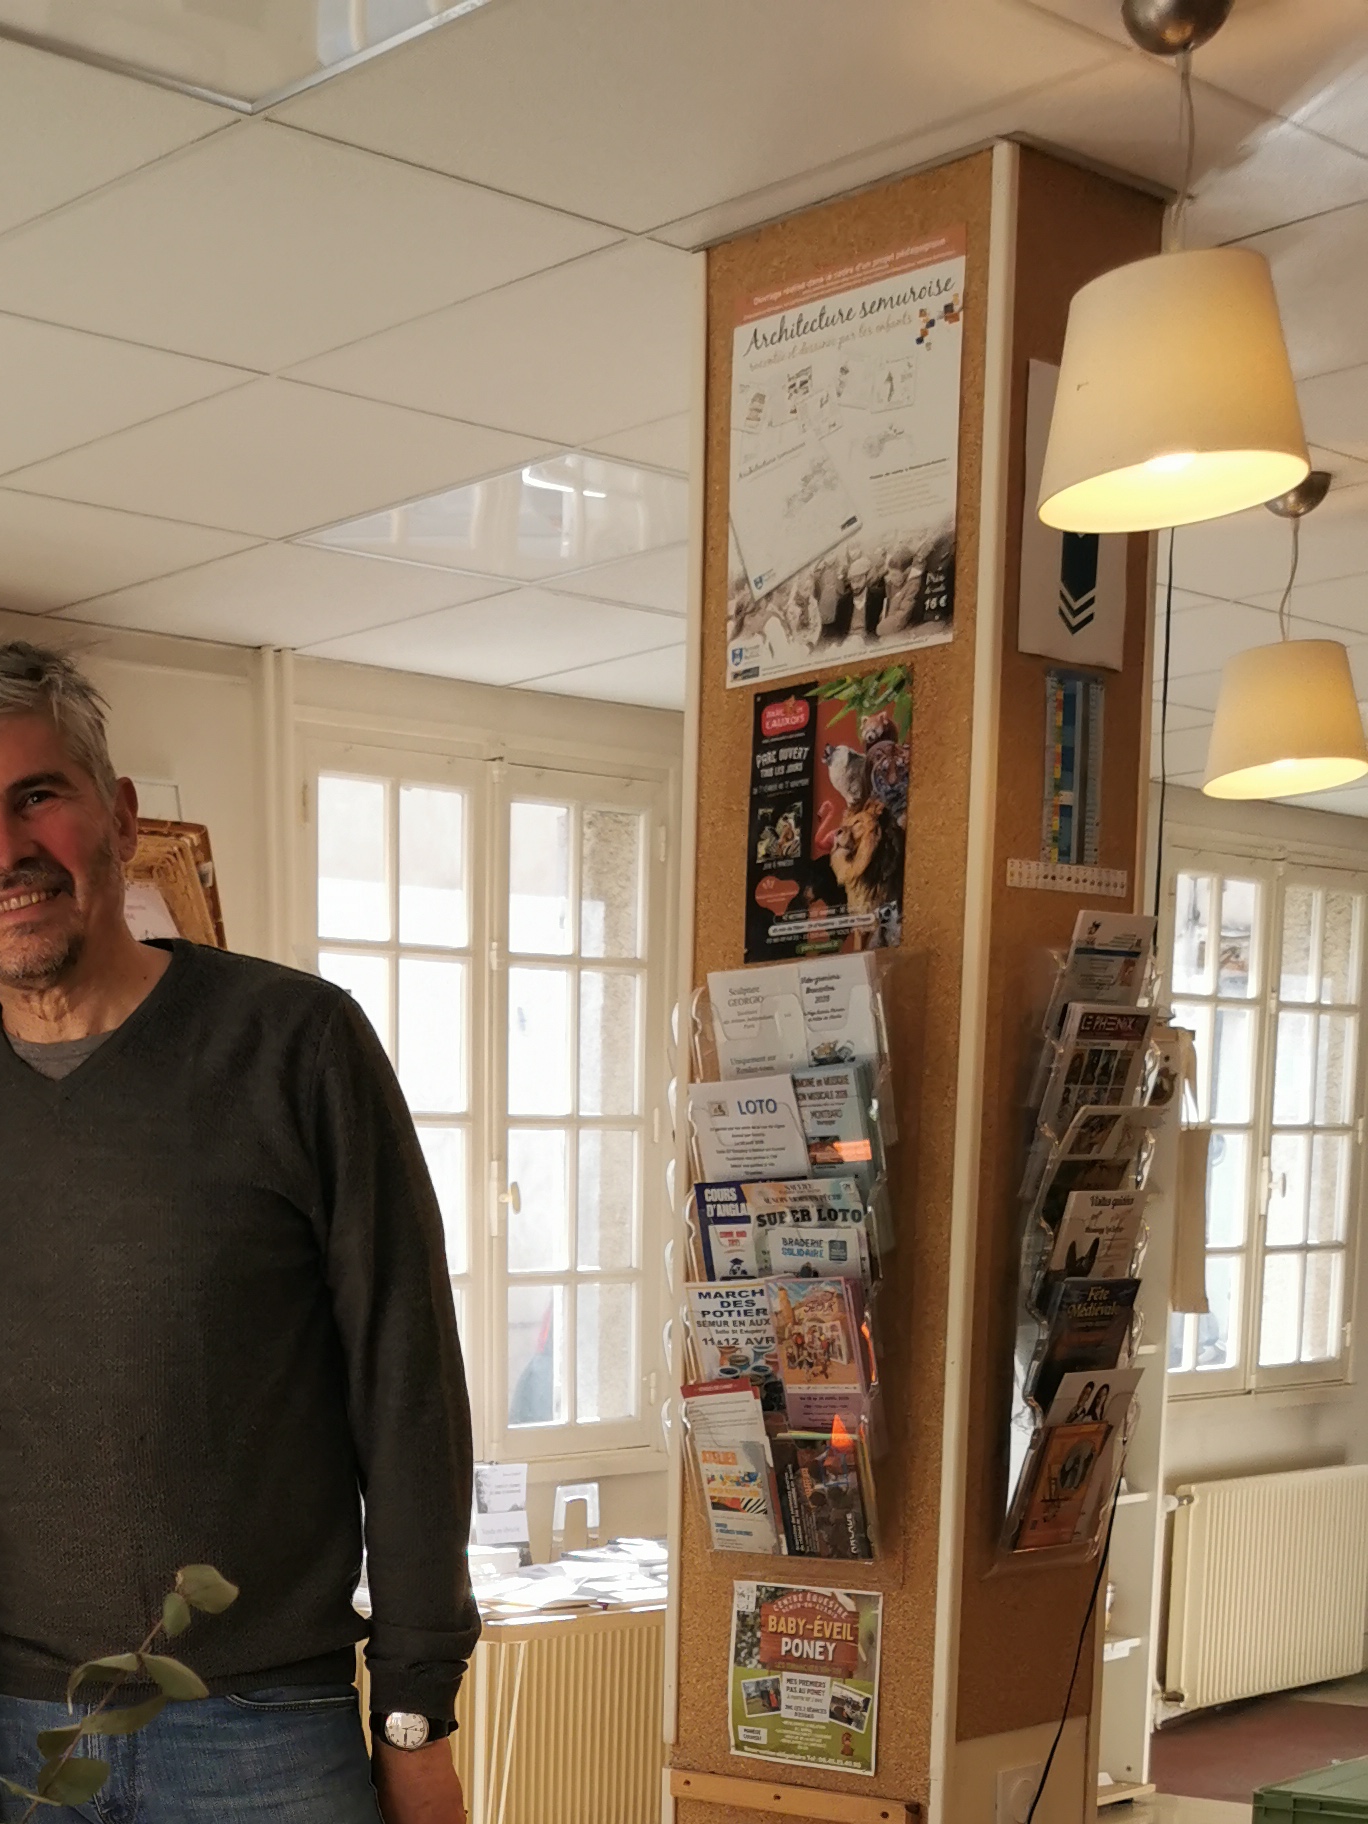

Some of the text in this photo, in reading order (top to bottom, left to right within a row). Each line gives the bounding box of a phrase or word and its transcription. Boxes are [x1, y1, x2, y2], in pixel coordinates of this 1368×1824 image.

[742, 304, 858, 357] Architecture
[859, 276, 956, 319] semuroise
[737, 1098, 778, 1116] LOTO
[704, 1187, 738, 1202] COURS
[706, 1202, 749, 1218] D'ANGLA
[816, 1208, 863, 1224] LOTO
[697, 1288, 766, 1300] MARCH
[720, 1299, 757, 1309] DES
[700, 1308, 769, 1319] POTIER
[732, 1319, 746, 1328] EN
[748, 1318, 772, 1328] AUX
[744, 1336, 776, 1346] AVR
[768, 1614, 855, 1641] BABY-ÉVEIL
[781, 1637, 837, 1661] PONEY
